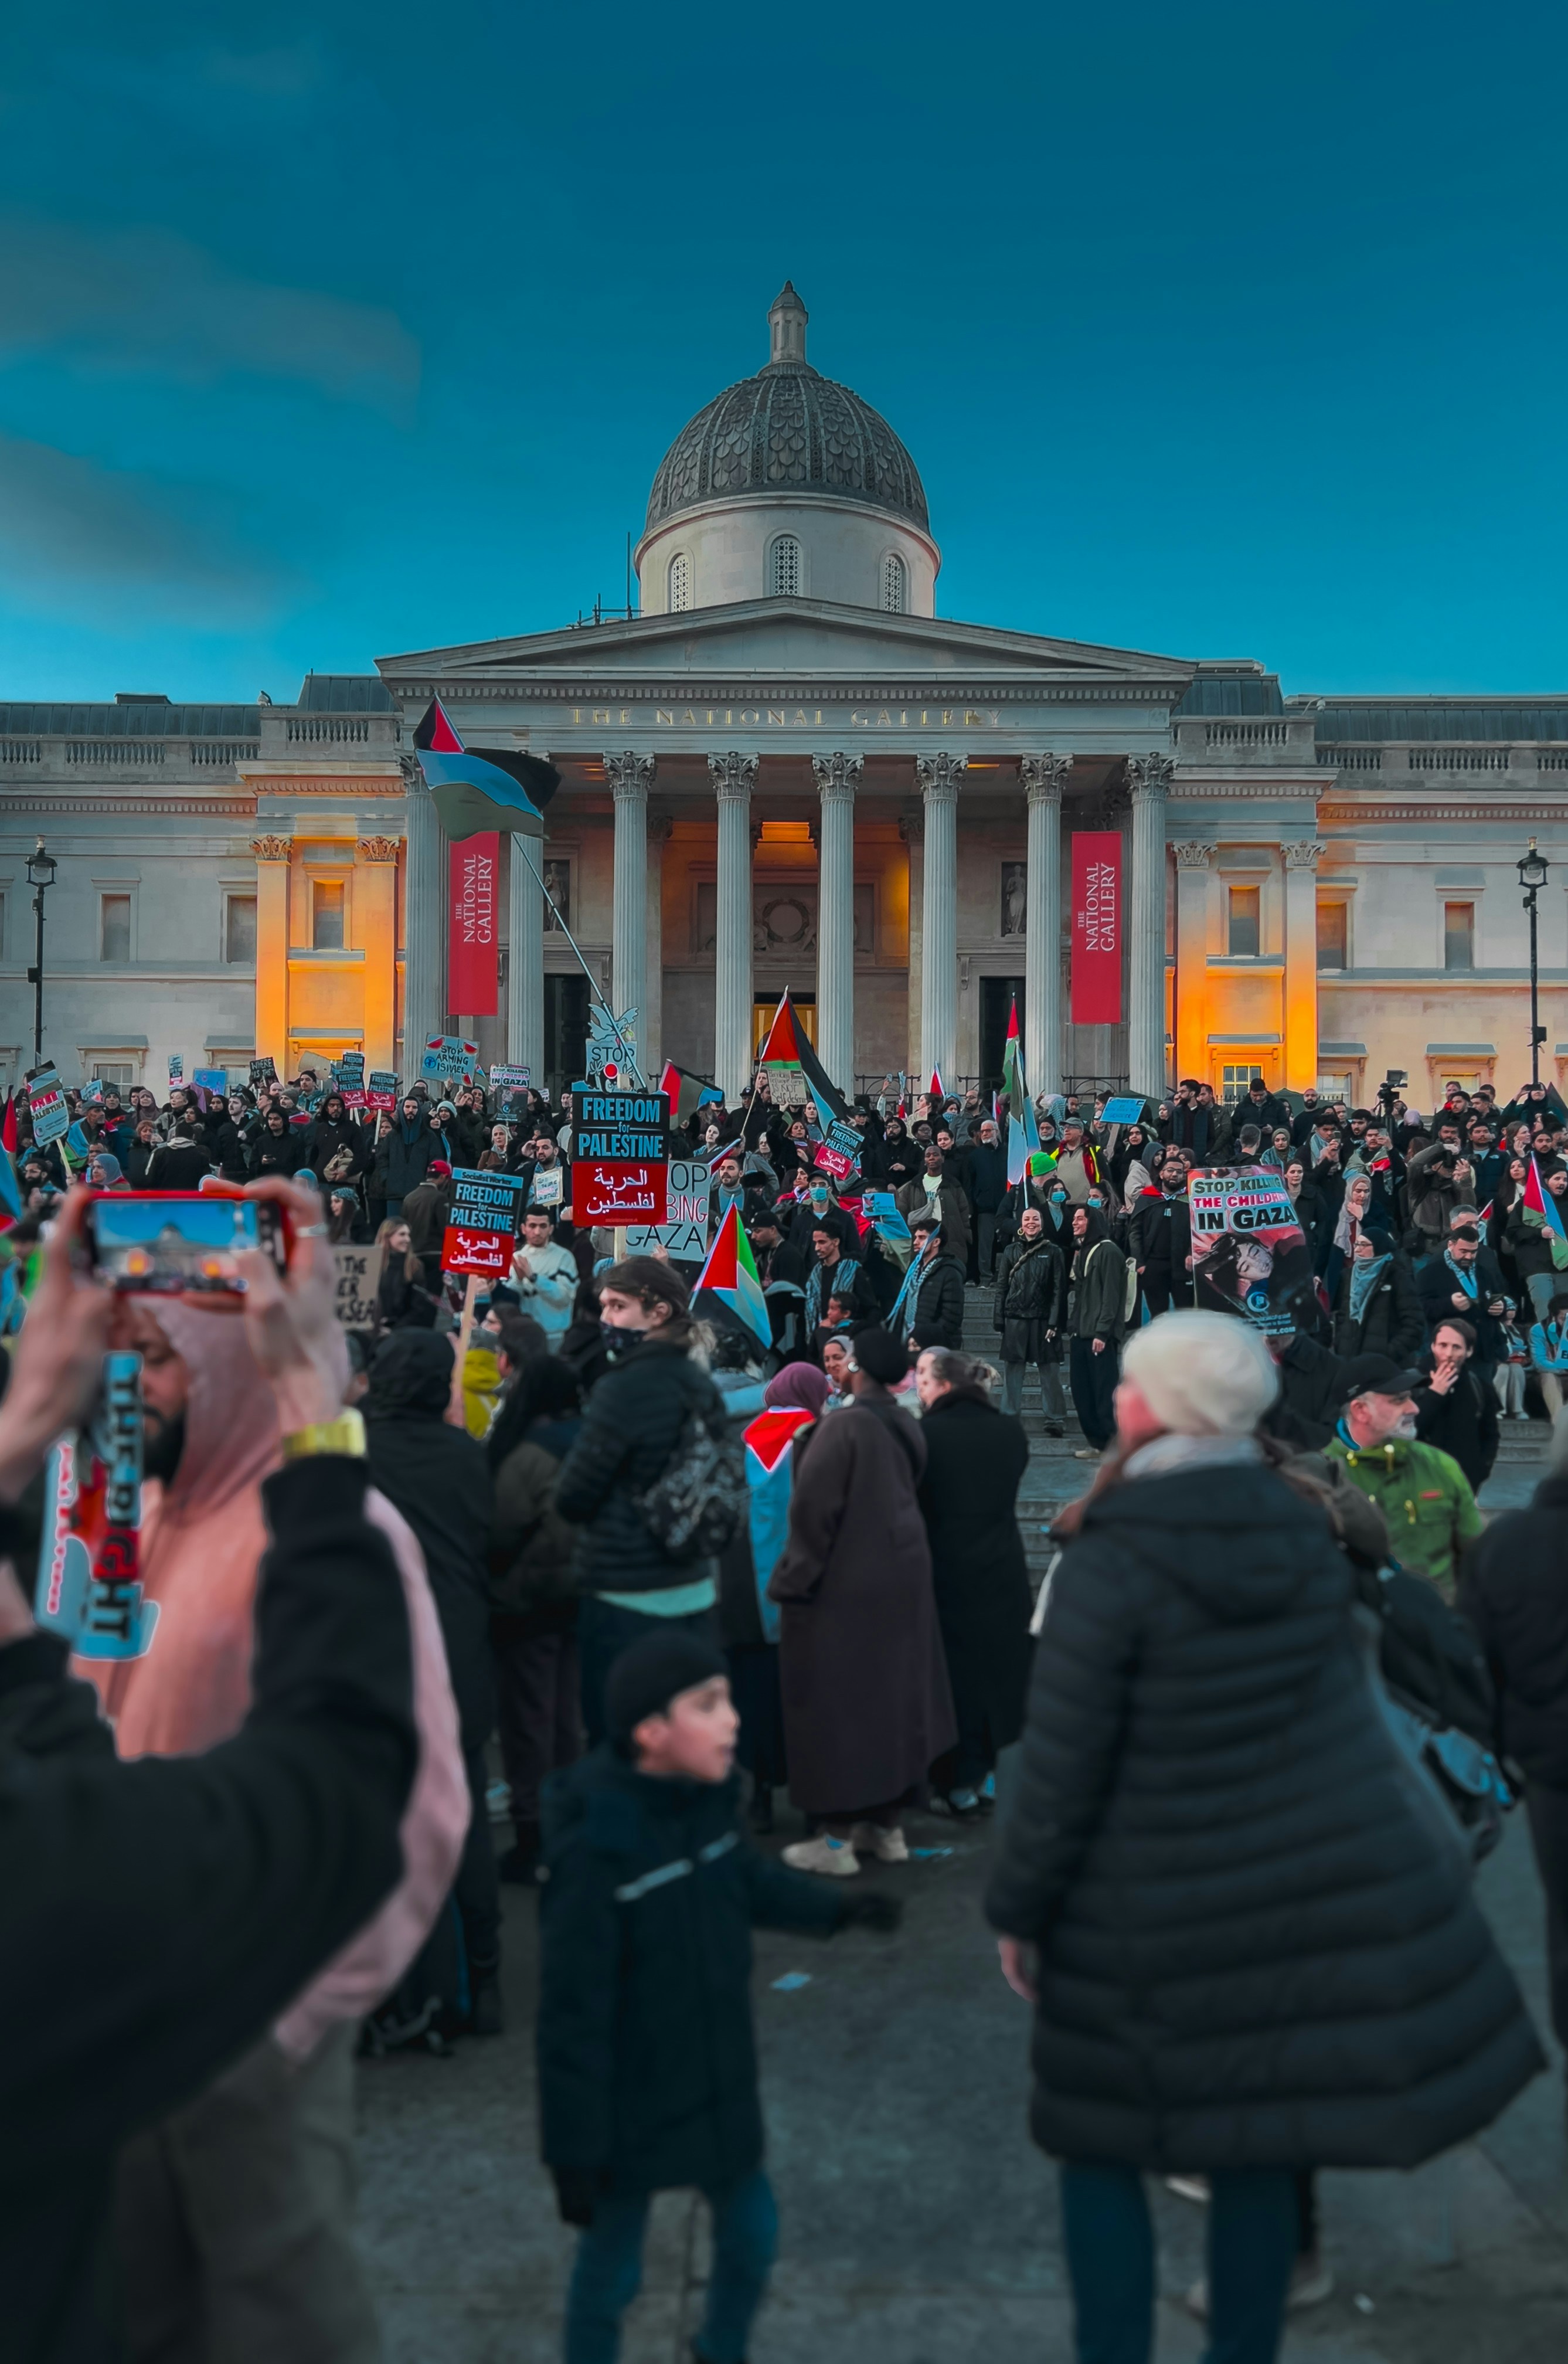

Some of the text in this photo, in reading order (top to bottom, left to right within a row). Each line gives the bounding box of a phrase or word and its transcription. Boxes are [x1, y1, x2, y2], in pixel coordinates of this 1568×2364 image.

[569, 708, 1005, 726] THE NATIONAL GALLERY
[464, 854, 476, 943] NATIONAL
[478, 854, 492, 944] GALLERY
[1086, 862, 1098, 951] NATIONAL
[1100, 862, 1115, 952] GALLERY
[436, 1053, 469, 1065] ARMING
[441, 1045, 464, 1055] STOP
[591, 1047, 635, 1062] STOP
[251, 1058, 273, 1070] WHERE
[339, 1073, 361, 1082] FREEDOM
[339, 1082, 363, 1091] PALESTINE
[372, 1075, 395, 1084] FREEDOM
[504, 1078, 528, 1086] GAZA
[369, 1084, 395, 1094] PALESTINE
[781, 1084, 797, 1093] NOT
[583, 1097, 660, 1123] FREEDOM
[618, 1122, 631, 1133] for
[579, 1133, 664, 1159] PALESTINE
[831, 1128, 859, 1148] FREEDOM
[825, 1138, 855, 1160] PALESTINE
[462, 1171, 489, 1182] Socialist
[594, 1167, 647, 1190] الحرية
[671, 1162, 708, 1194] OP
[1194, 1177, 1281, 1194] STOP KILLING
[455, 1183, 514, 1207] FREEDOM
[586, 1191, 655, 1214] لفلسطين
[1193, 1191, 1288, 1209] THE CHILDREN
[477, 1203, 488, 1211] for
[666, 1193, 709, 1224] BING
[450, 1207, 514, 1232] PALESTINE
[1198, 1205, 1296, 1231] IN GAZA
[457, 1231, 499, 1252] الحرية
[625, 1222, 705, 1255] GAZA
[449, 1249, 504, 1267] لفلسطين
